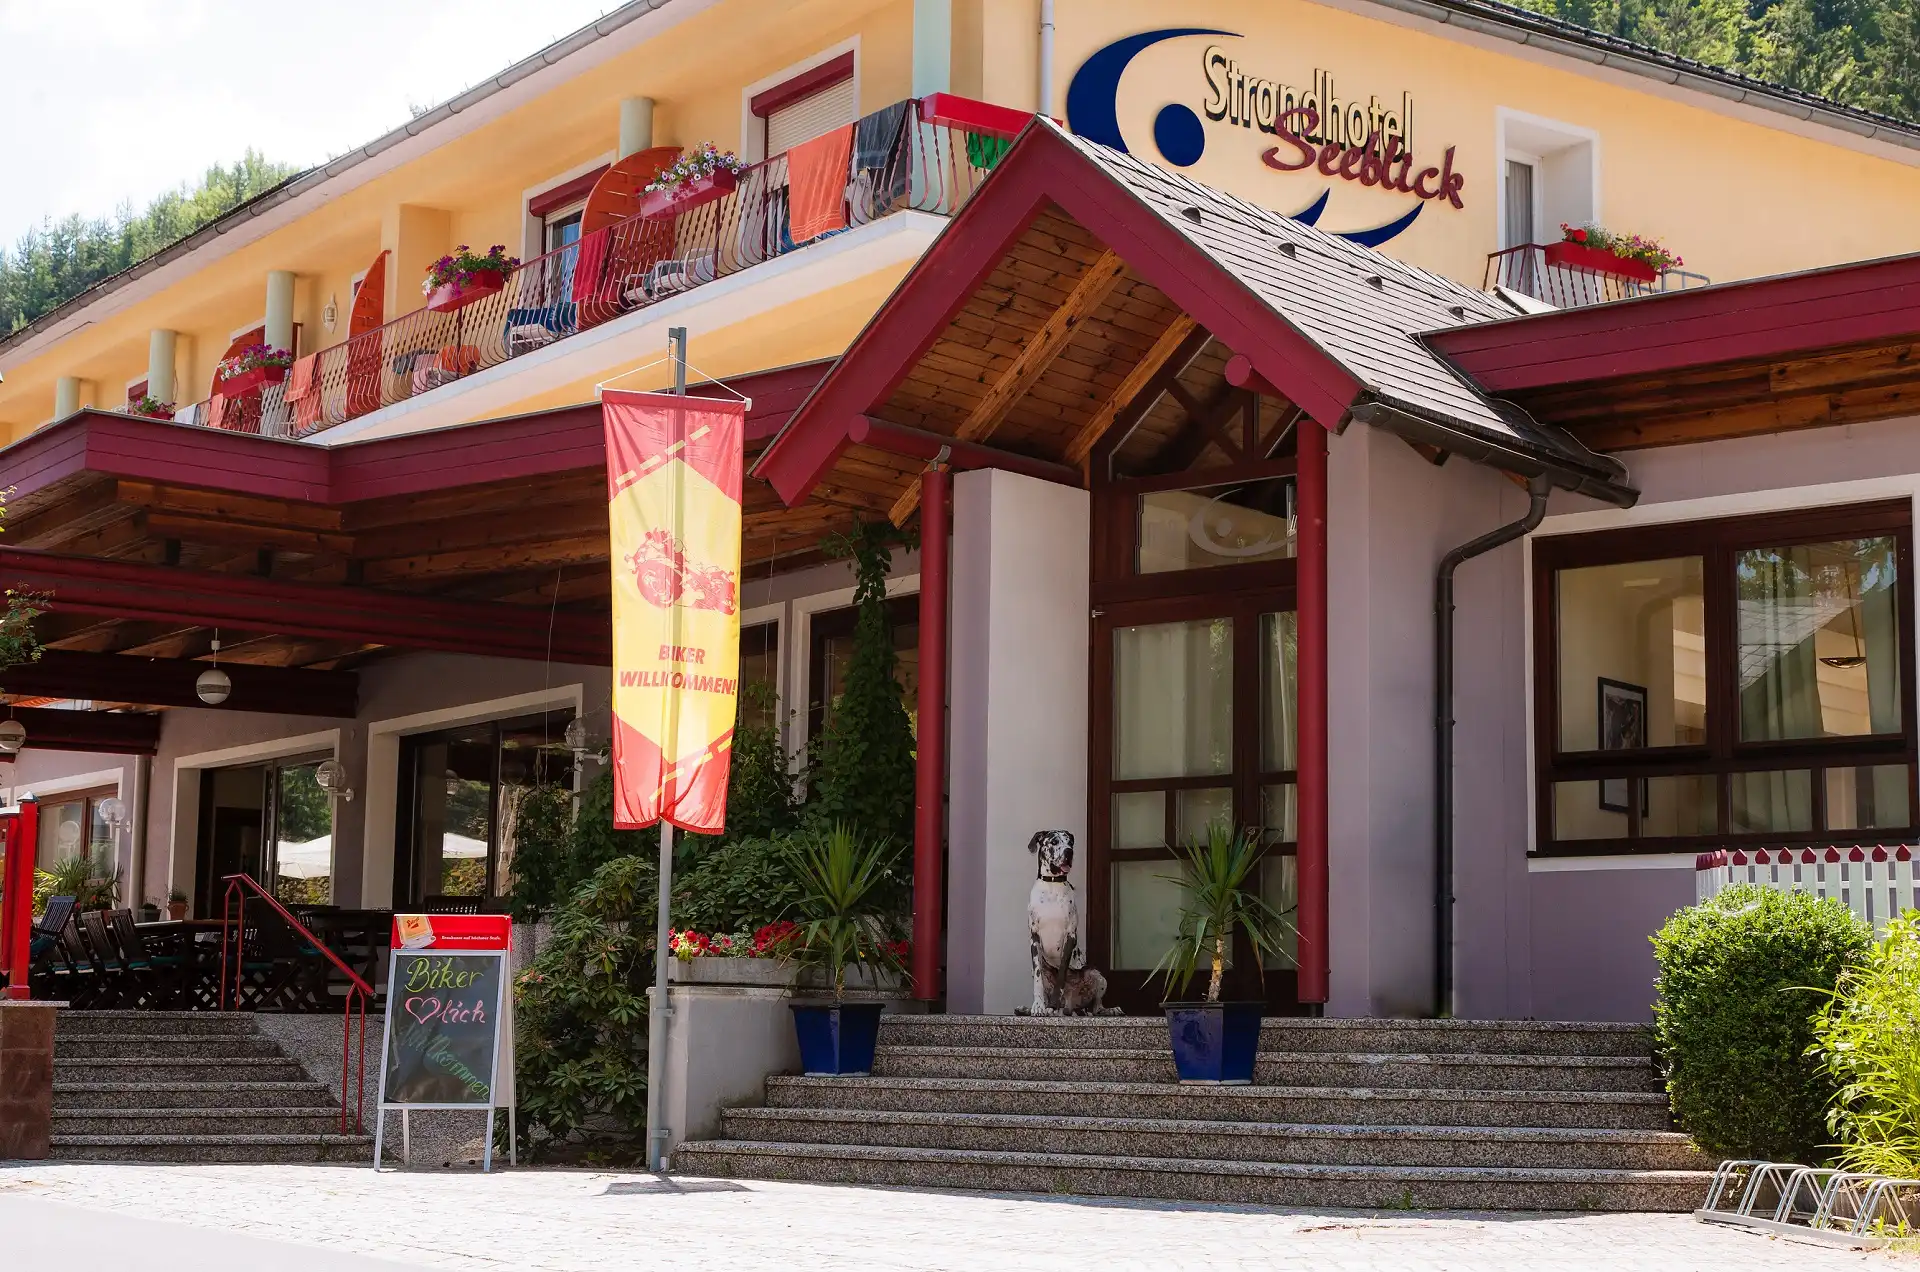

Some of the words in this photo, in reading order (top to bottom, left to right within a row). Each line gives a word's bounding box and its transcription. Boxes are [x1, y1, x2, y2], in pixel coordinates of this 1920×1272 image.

[1204, 45, 1413, 159] Strandhotel
[1261, 106, 1465, 210] Seeblick
[658, 643, 706, 665] BIKER
[404, 957, 485, 993] Biker
